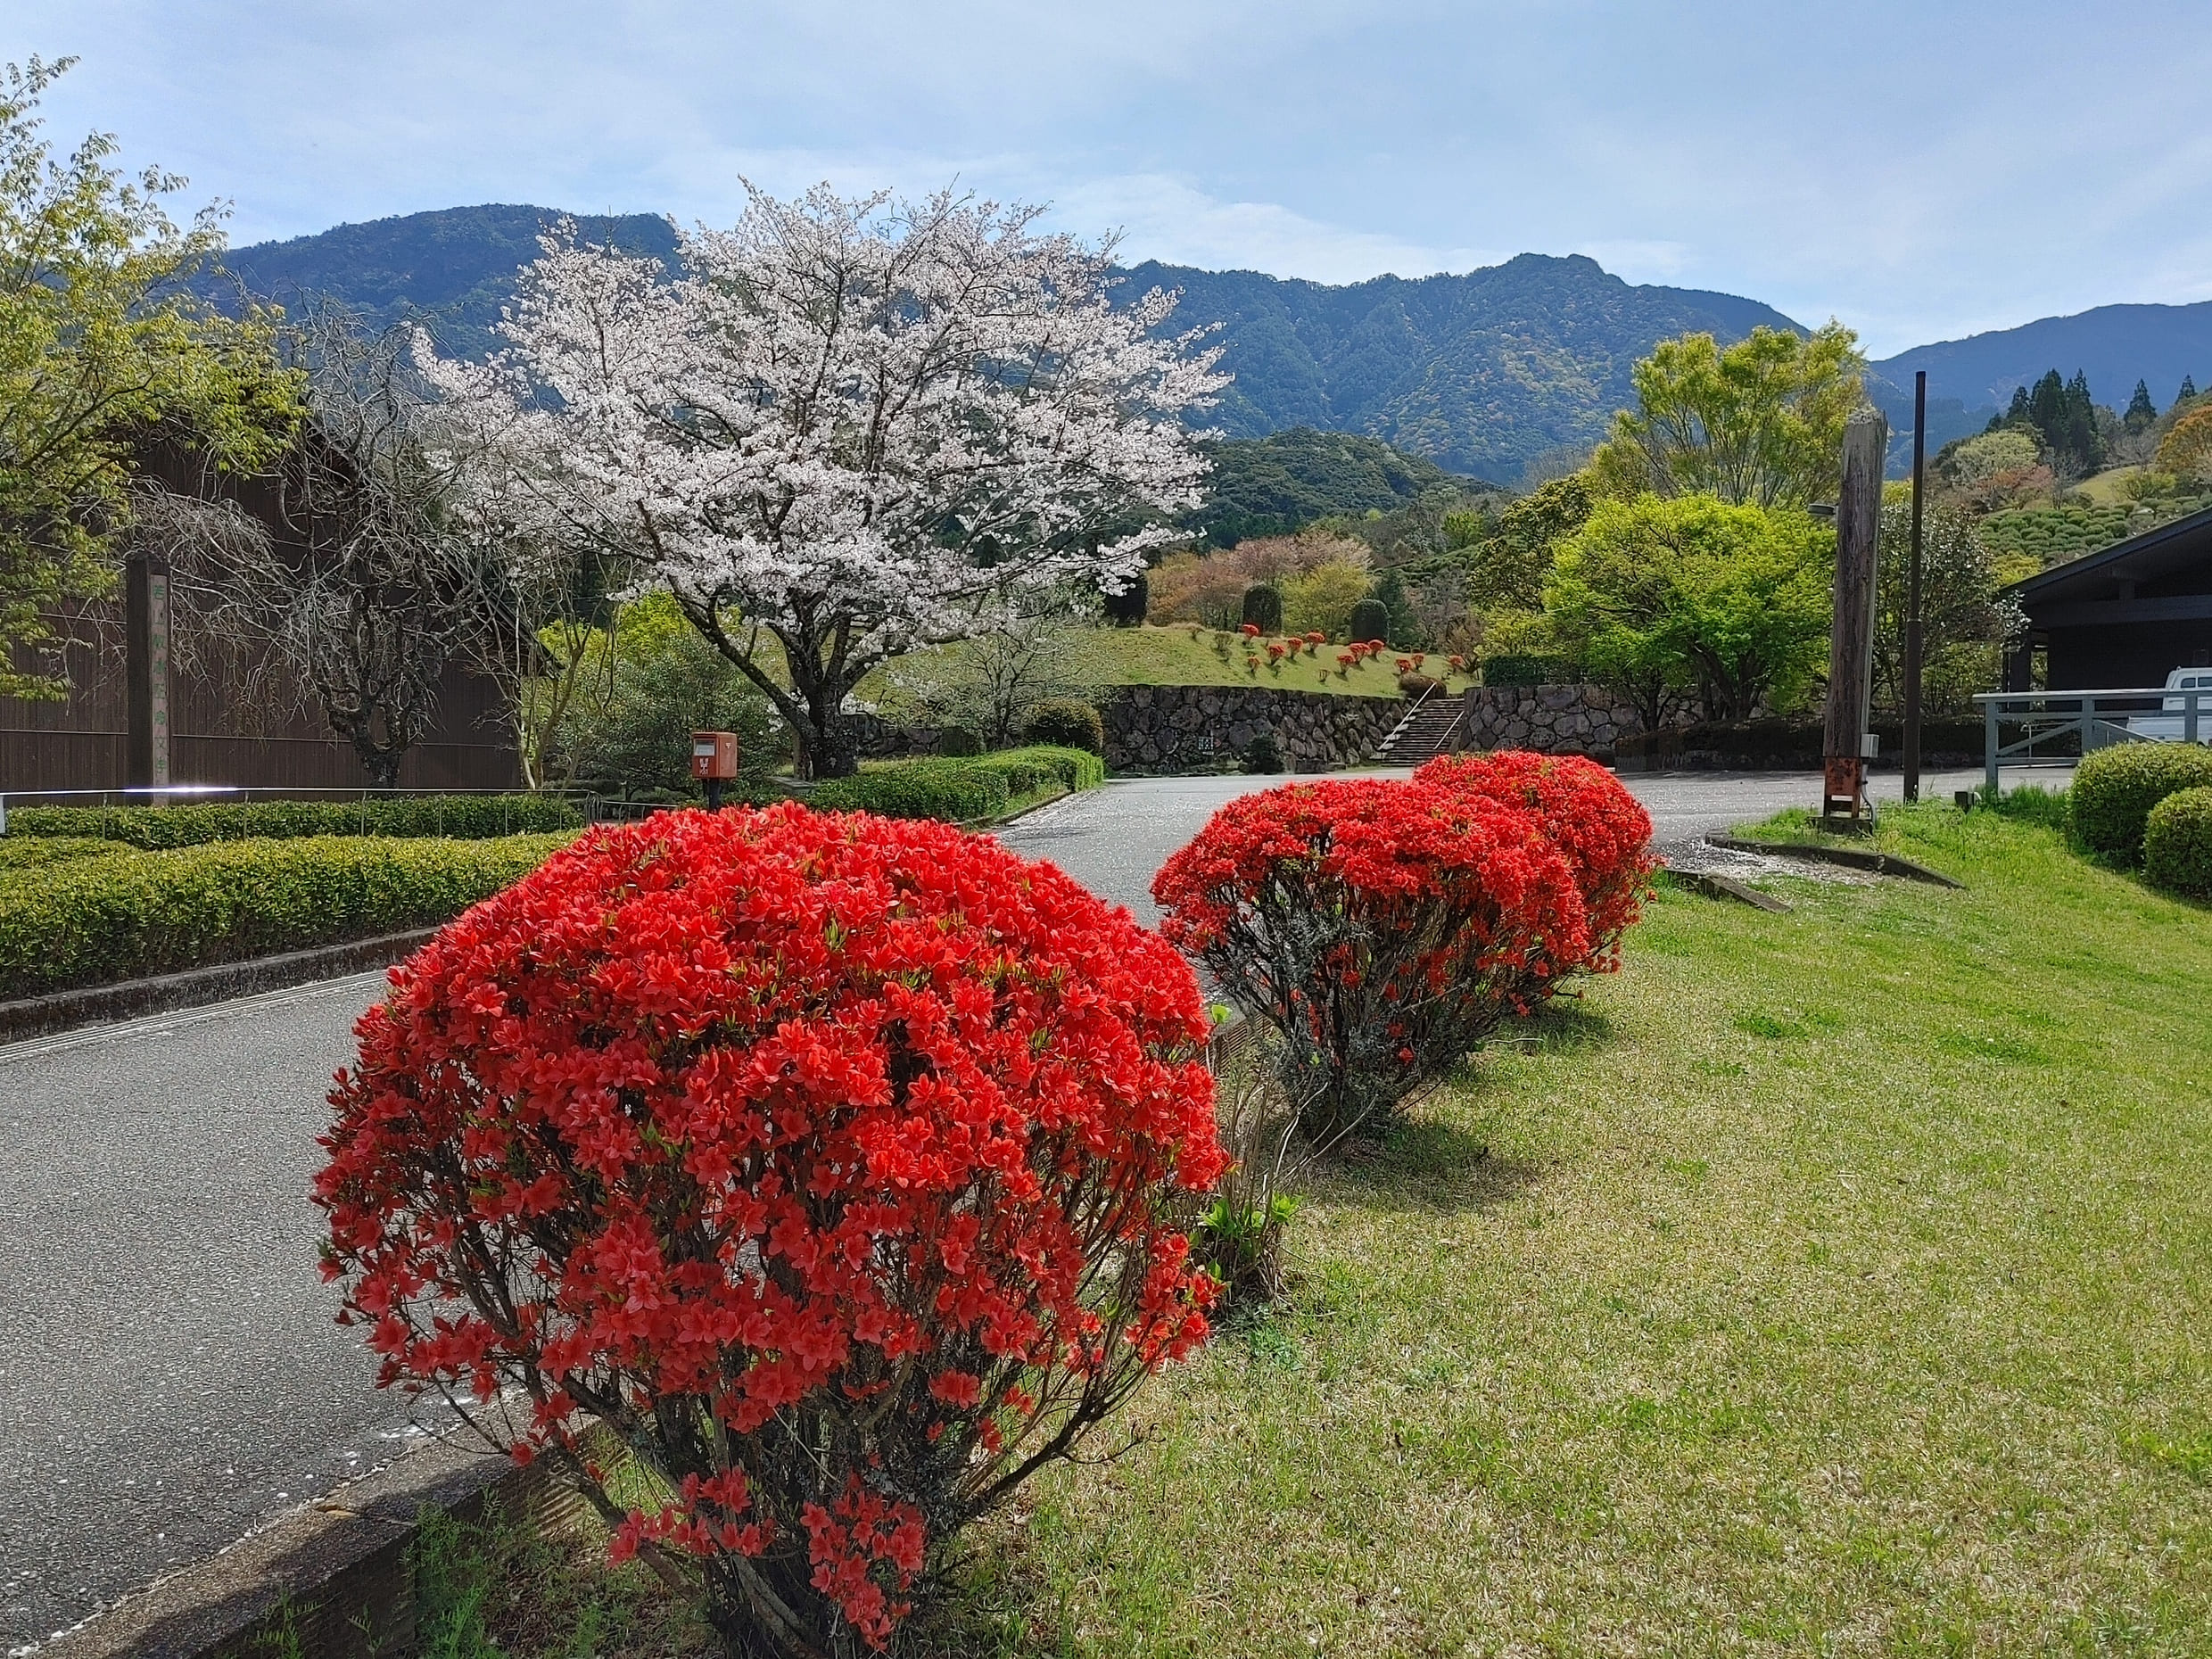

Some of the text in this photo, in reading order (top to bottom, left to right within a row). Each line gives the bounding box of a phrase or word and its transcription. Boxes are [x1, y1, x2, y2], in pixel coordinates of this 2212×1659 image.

[153, 584, 168, 788] 若山牧水記念文学
